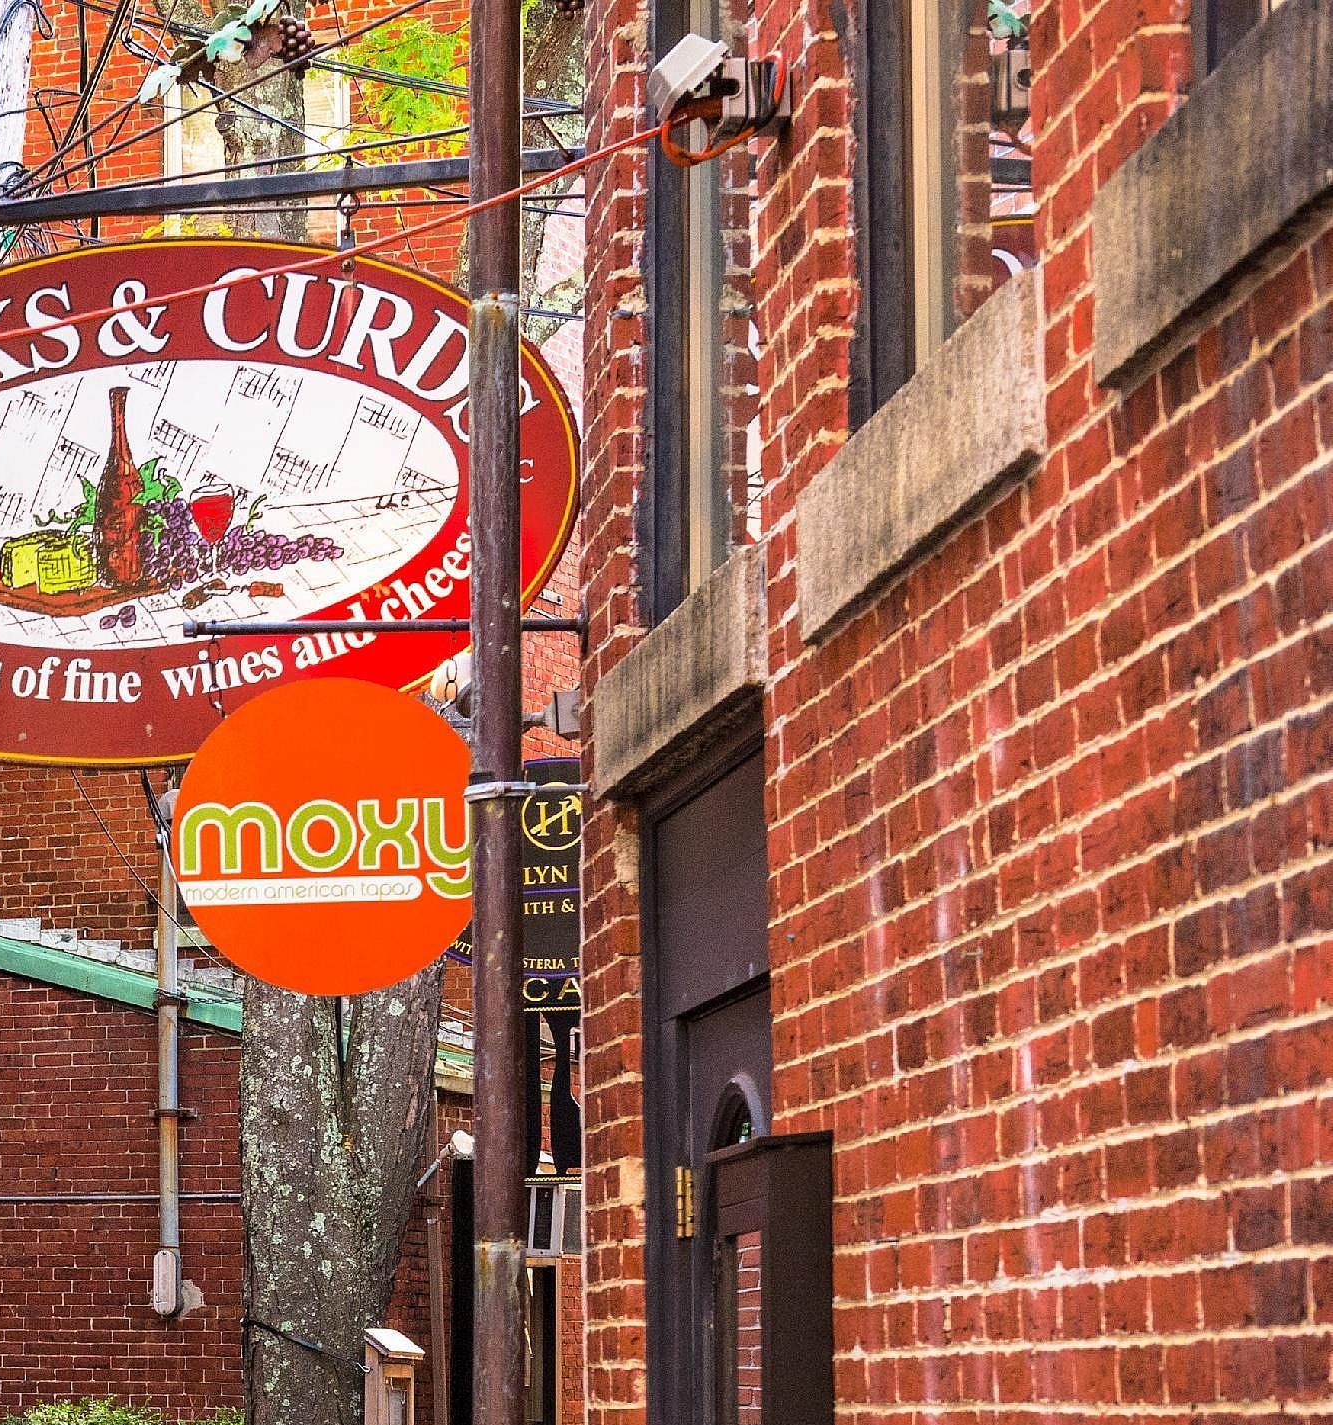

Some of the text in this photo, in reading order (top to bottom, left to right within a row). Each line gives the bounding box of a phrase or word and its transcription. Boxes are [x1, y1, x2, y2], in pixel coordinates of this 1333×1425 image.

[98, 279, 169, 357] &
[12, 656, 60, 699] of
[64, 657, 142, 703] fine
[161, 648, 284, 701] wines
[292, 601, 379, 667] and
[178, 797, 473, 899] moxy
[185, 880, 414, 902] modern american tapas
